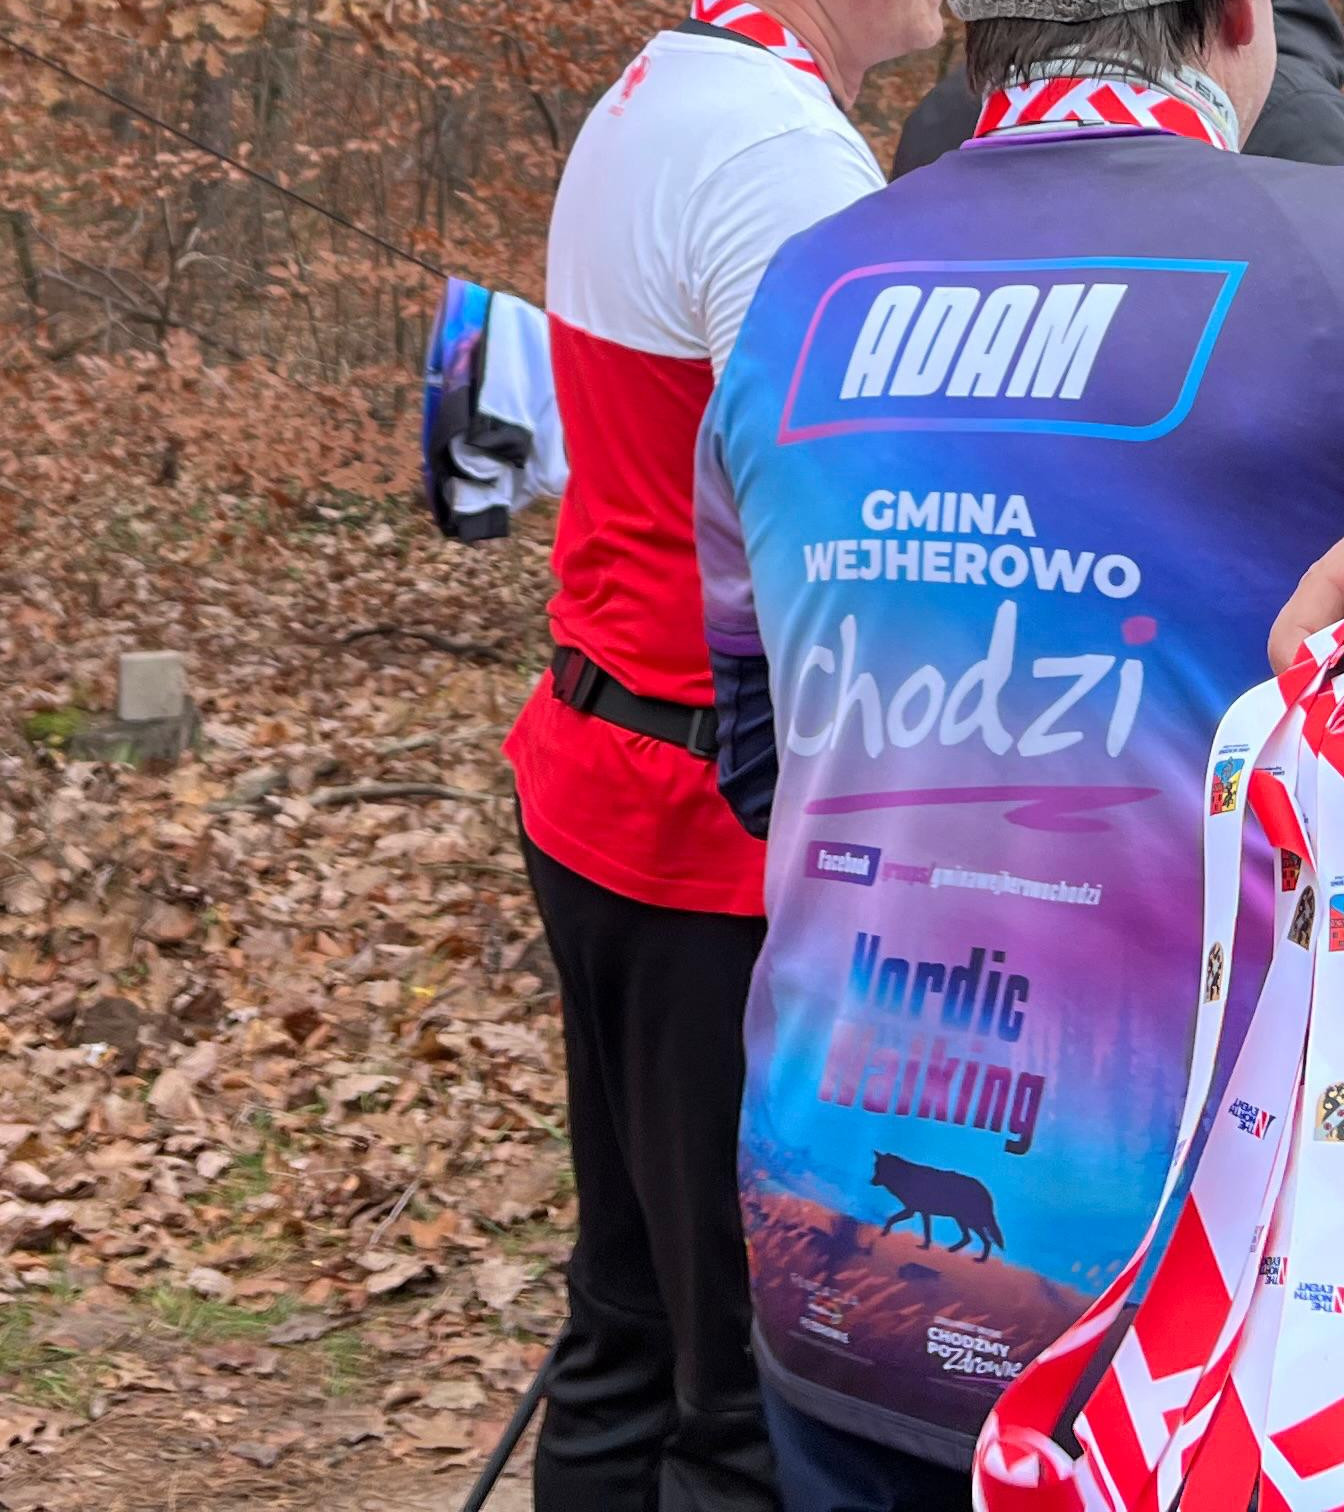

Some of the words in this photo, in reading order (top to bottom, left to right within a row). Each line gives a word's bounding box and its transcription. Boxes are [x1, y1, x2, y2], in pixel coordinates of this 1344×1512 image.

[838, 283, 1129, 400] ADAM
[861, 489, 1037, 538] GMINA
[803, 539, 1142, 599] WEJHEROWO
[848, 930, 1031, 1043] Nordic
